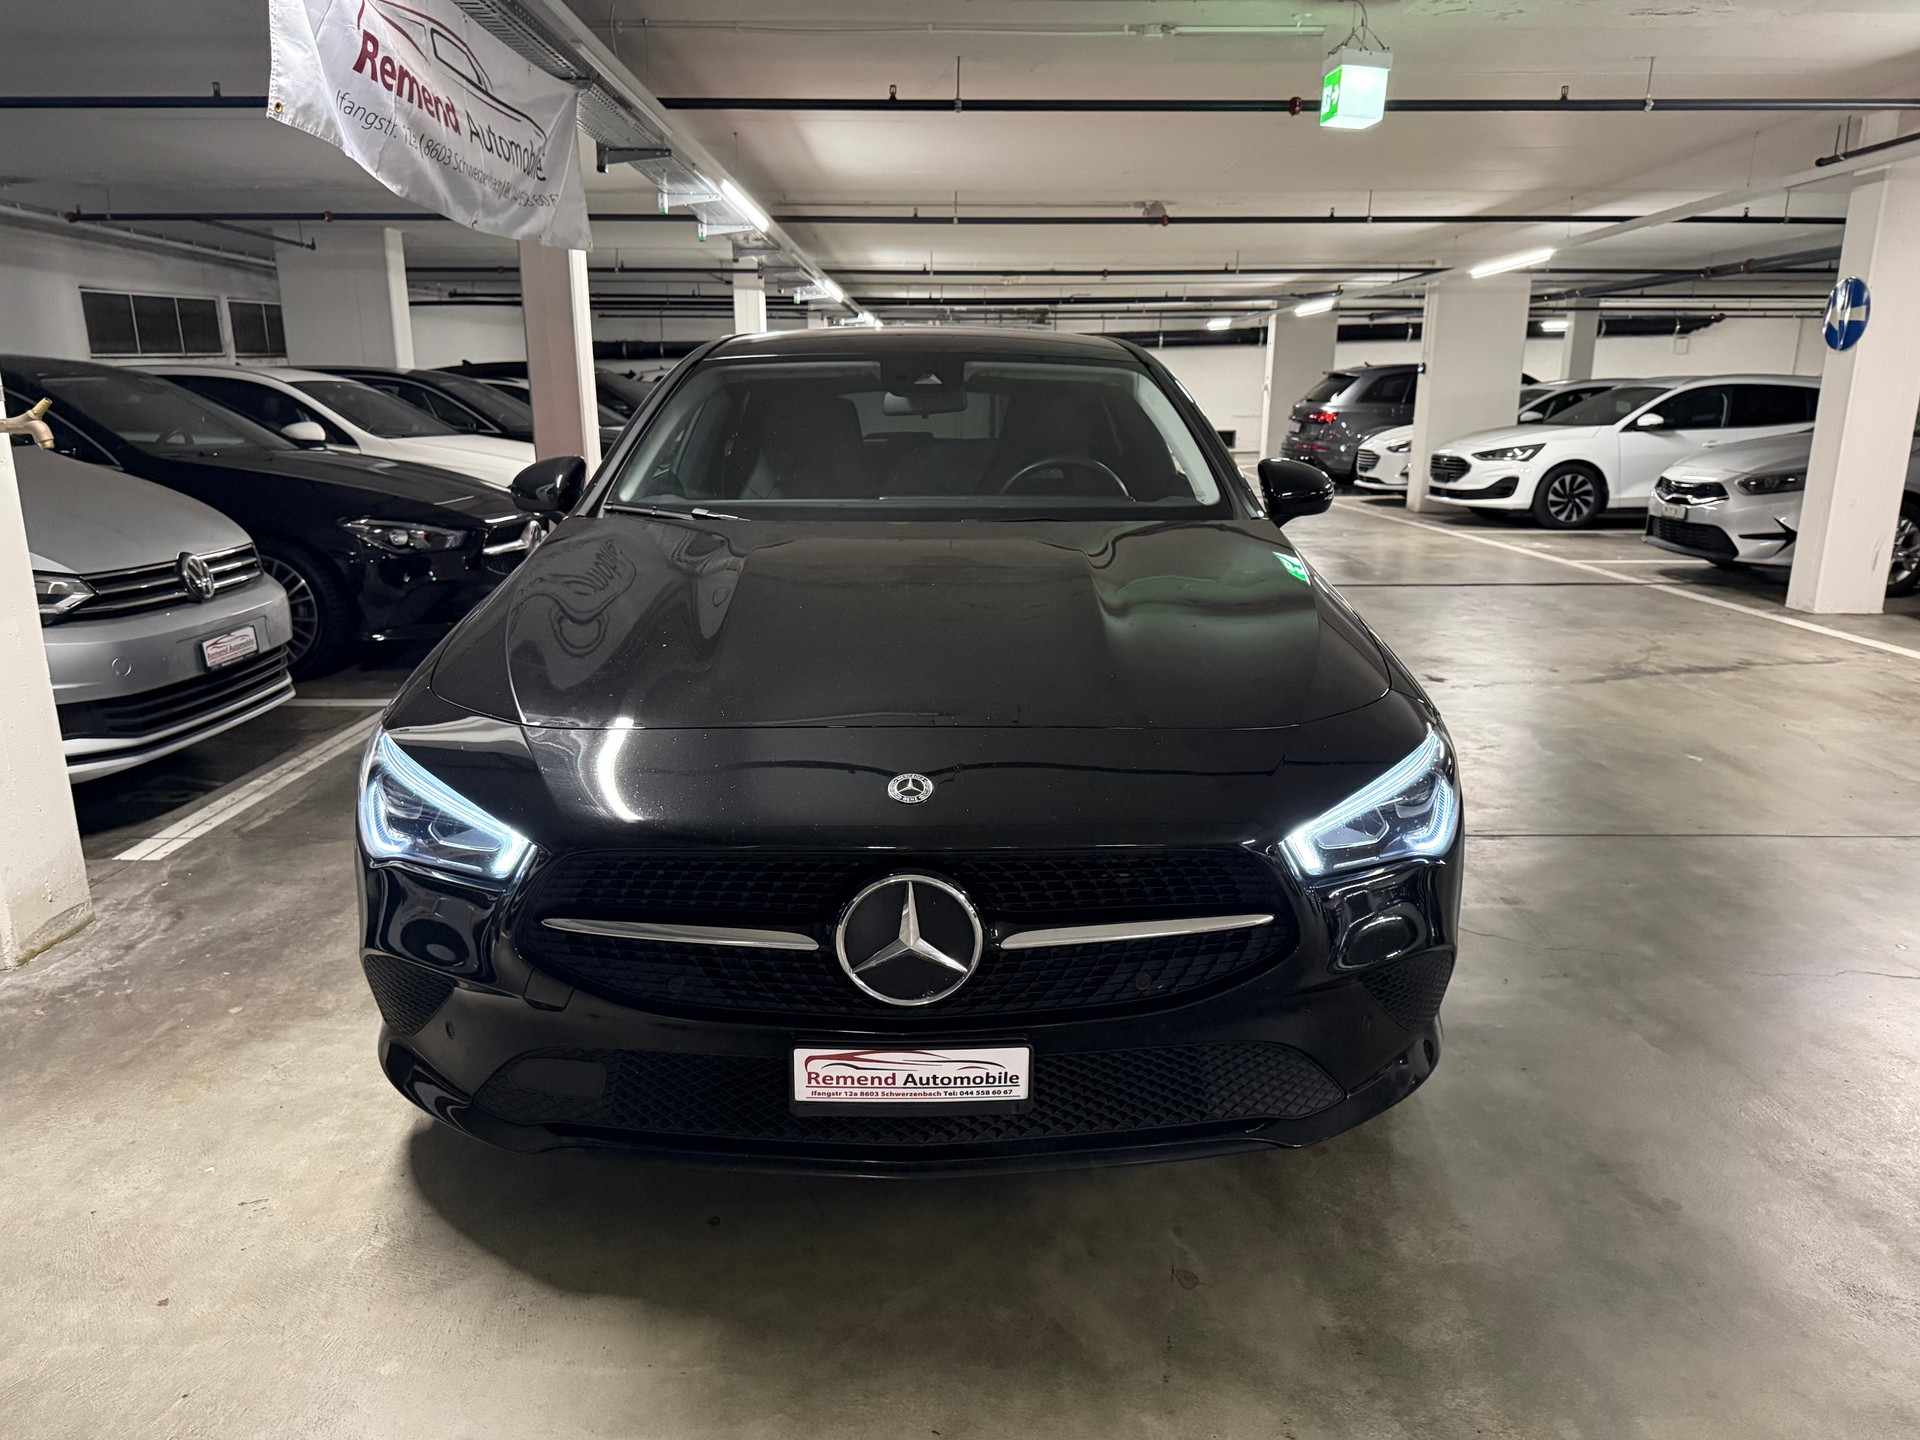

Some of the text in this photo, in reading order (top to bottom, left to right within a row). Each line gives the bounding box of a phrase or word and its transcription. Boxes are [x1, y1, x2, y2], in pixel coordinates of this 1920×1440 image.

[352, 28, 462, 136] Remend
[423, 138, 453, 166] 8603
[807, 1071, 1020, 1086] Remend Automobile
[811, 1090, 842, 1098] Ifangstr
